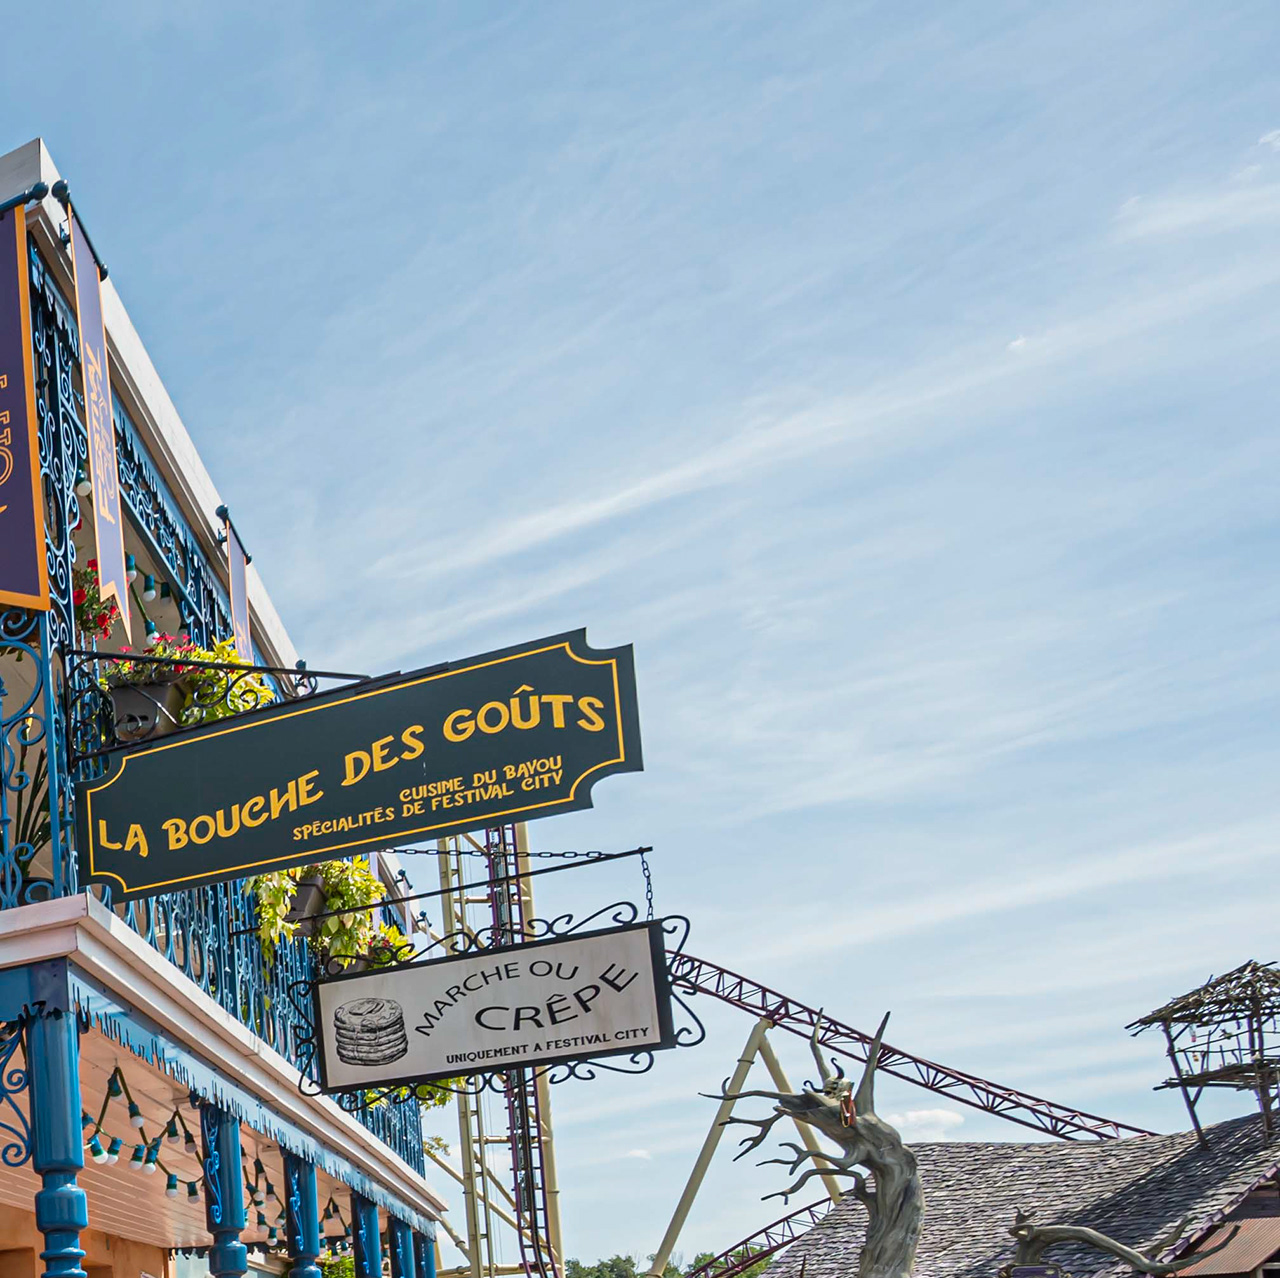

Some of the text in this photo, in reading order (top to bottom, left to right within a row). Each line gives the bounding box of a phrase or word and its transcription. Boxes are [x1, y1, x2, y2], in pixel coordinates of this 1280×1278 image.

[98, 684, 607, 858] LA BOUCHE DES GOÛTS
[292, 769, 563, 841] SPÉCIALITÉS DE FESTIVAL CITY
[399, 755, 562, 803] CUISINE DU BAYOU
[413, 959, 581, 1038] MARCHE OU
[474, 961, 642, 1032] CRÊPE
[445, 1026, 651, 1066] UNIQUEMENT A FESTIVAL CITY
